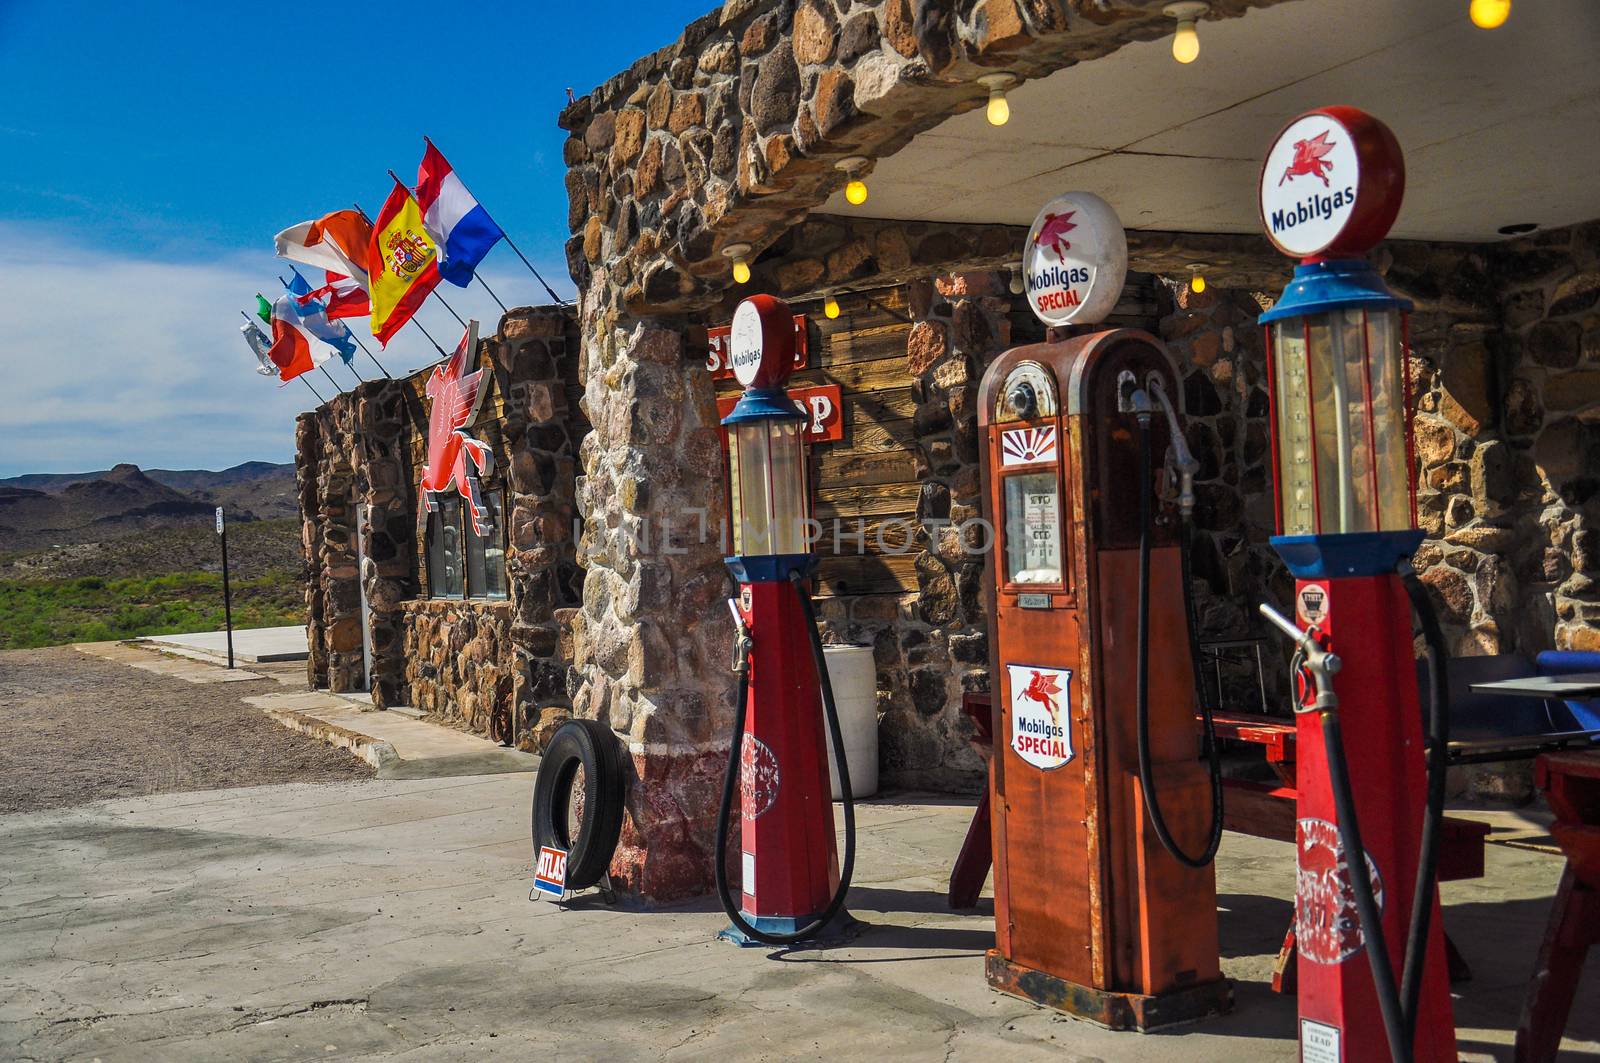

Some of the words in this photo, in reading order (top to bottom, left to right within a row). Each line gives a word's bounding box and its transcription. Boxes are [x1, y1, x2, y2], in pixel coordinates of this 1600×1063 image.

[1272, 186, 1354, 233] Mobilgas
[1028, 266, 1089, 291] Mobilgas
[1037, 290, 1081, 312] SPECIAL
[734, 347, 761, 366] Mobilgas
[1018, 716, 1064, 739] Mobilgas
[1017, 735, 1067, 758] SPECIAL
[537, 851, 567, 881] ATLAS
[1310, 1034, 1331, 1047] LEAD
